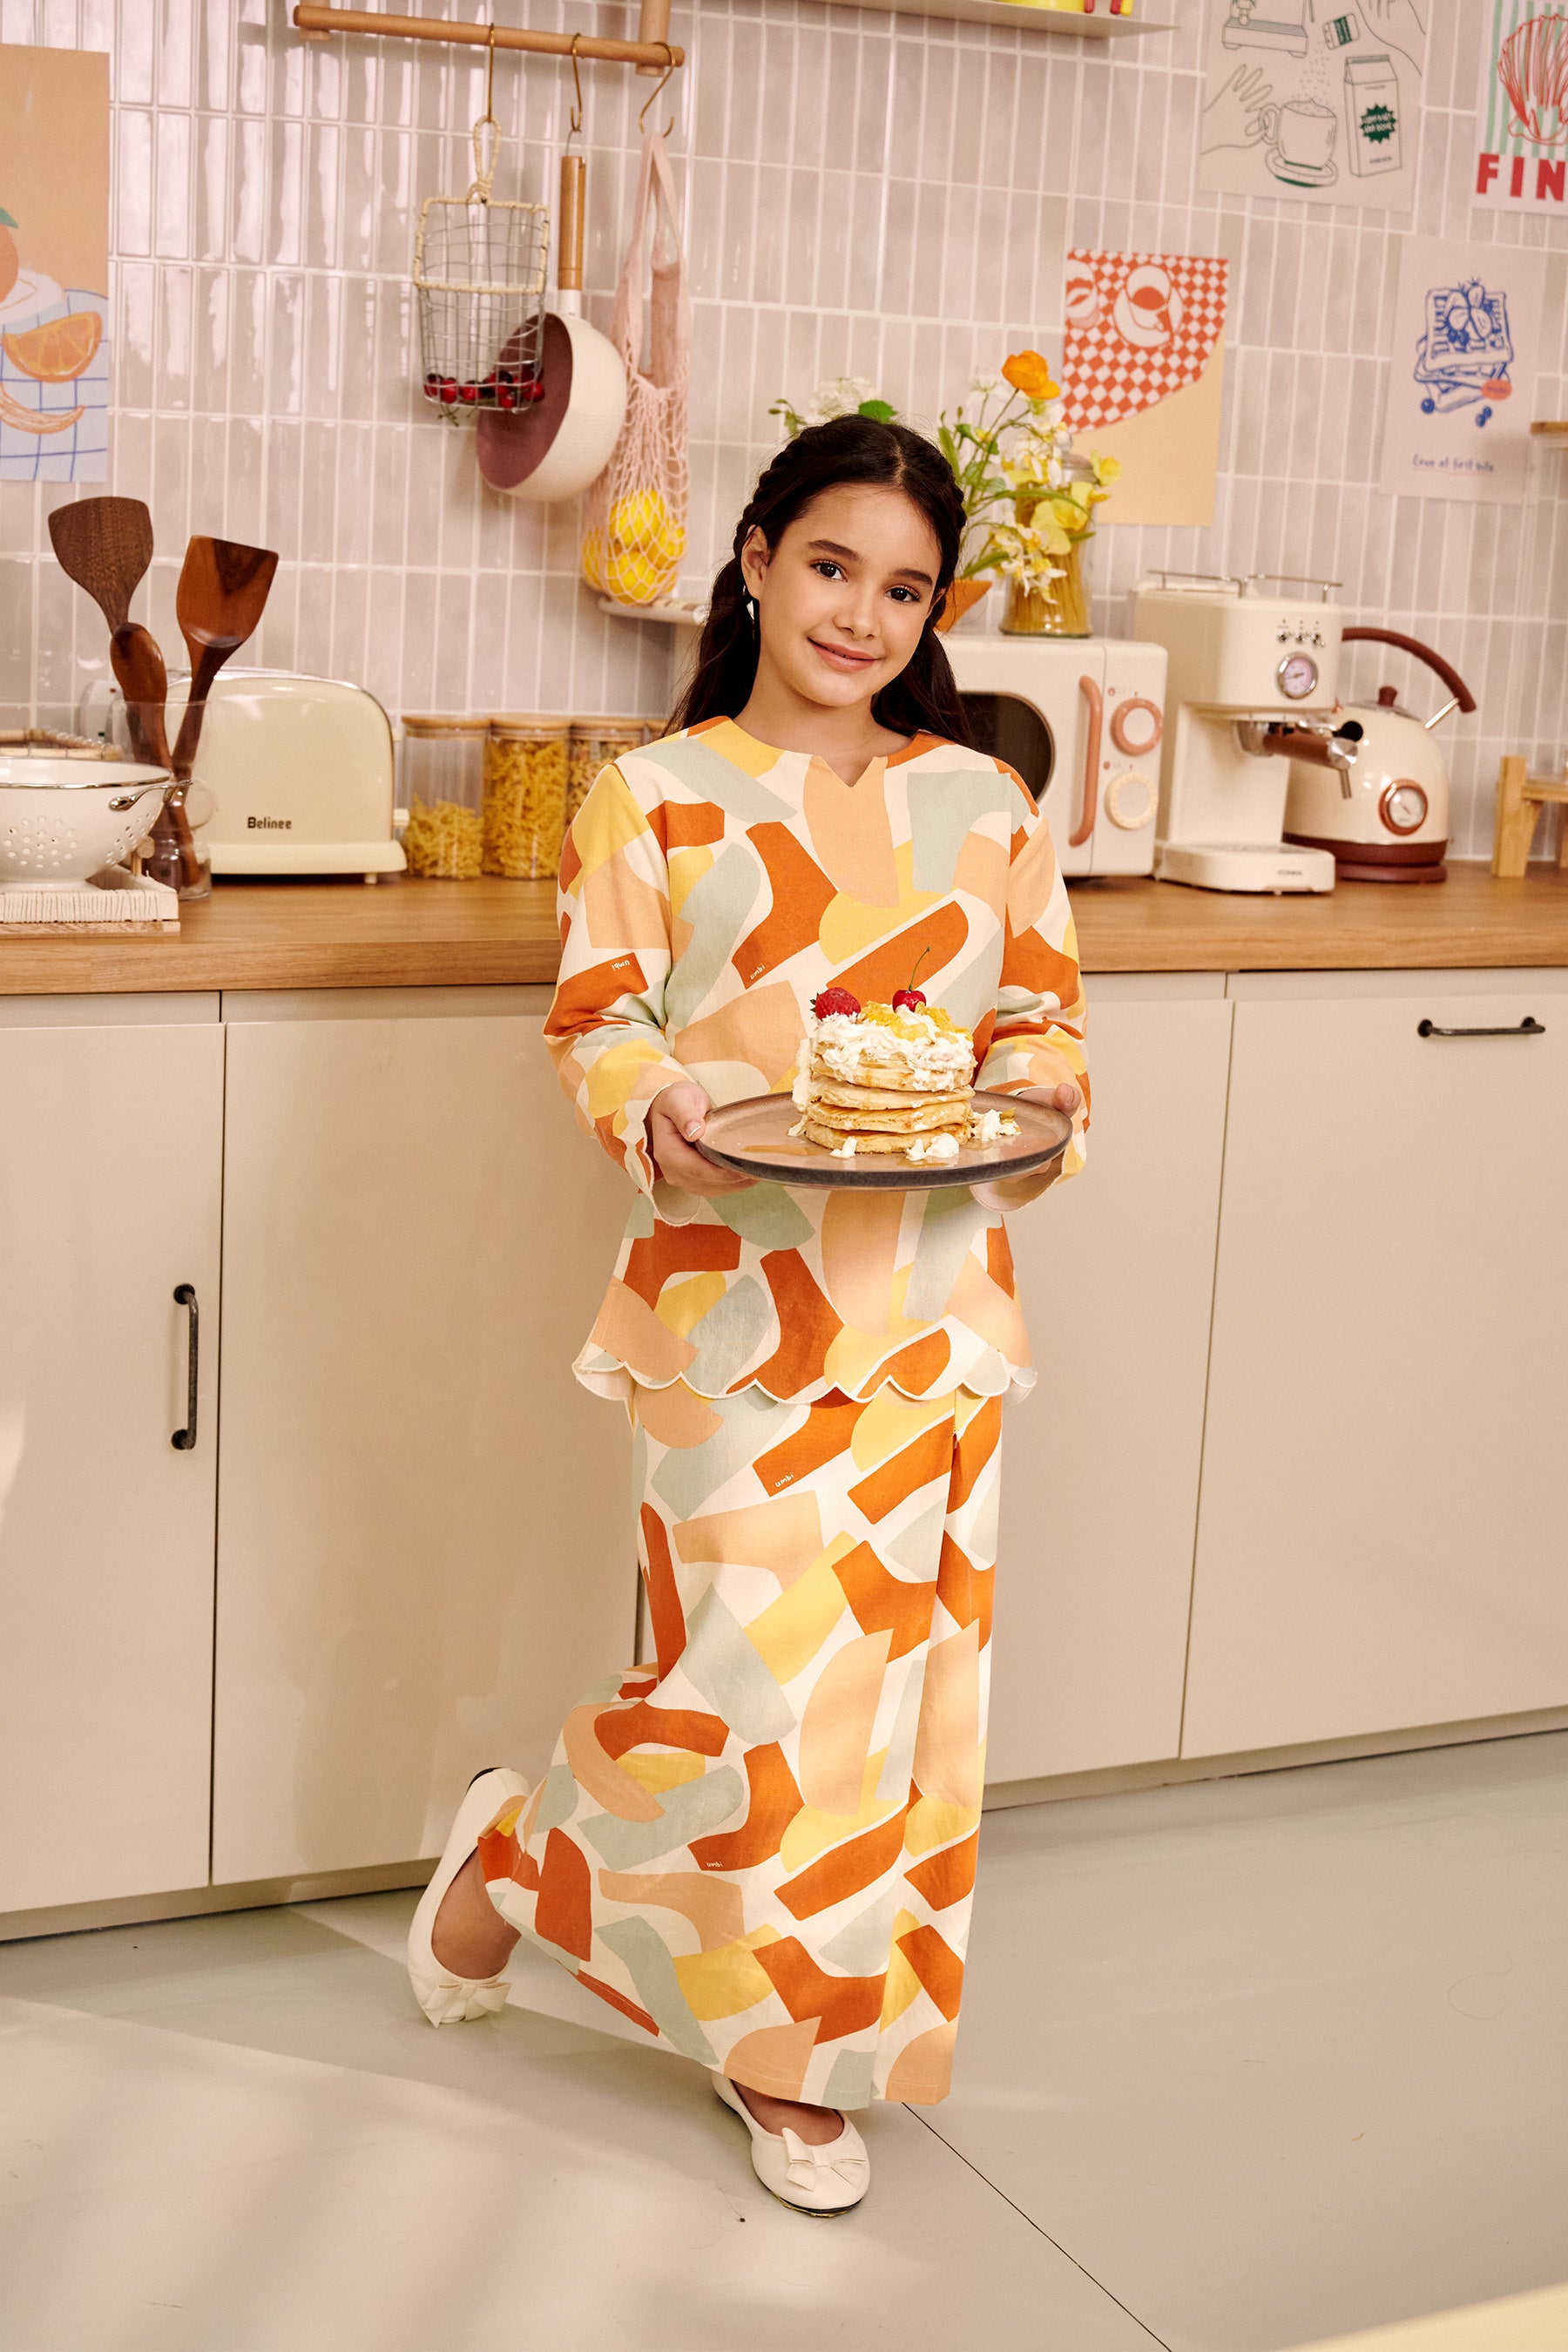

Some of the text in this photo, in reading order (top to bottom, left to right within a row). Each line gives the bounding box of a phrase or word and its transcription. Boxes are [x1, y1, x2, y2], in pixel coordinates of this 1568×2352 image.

[1477, 153, 1566, 202] FIN
[247, 816, 292, 829] Belinee
[611, 959, 631, 971] umbi
[750, 963, 766, 980] umbi
[774, 1471, 794, 1488] umbi
